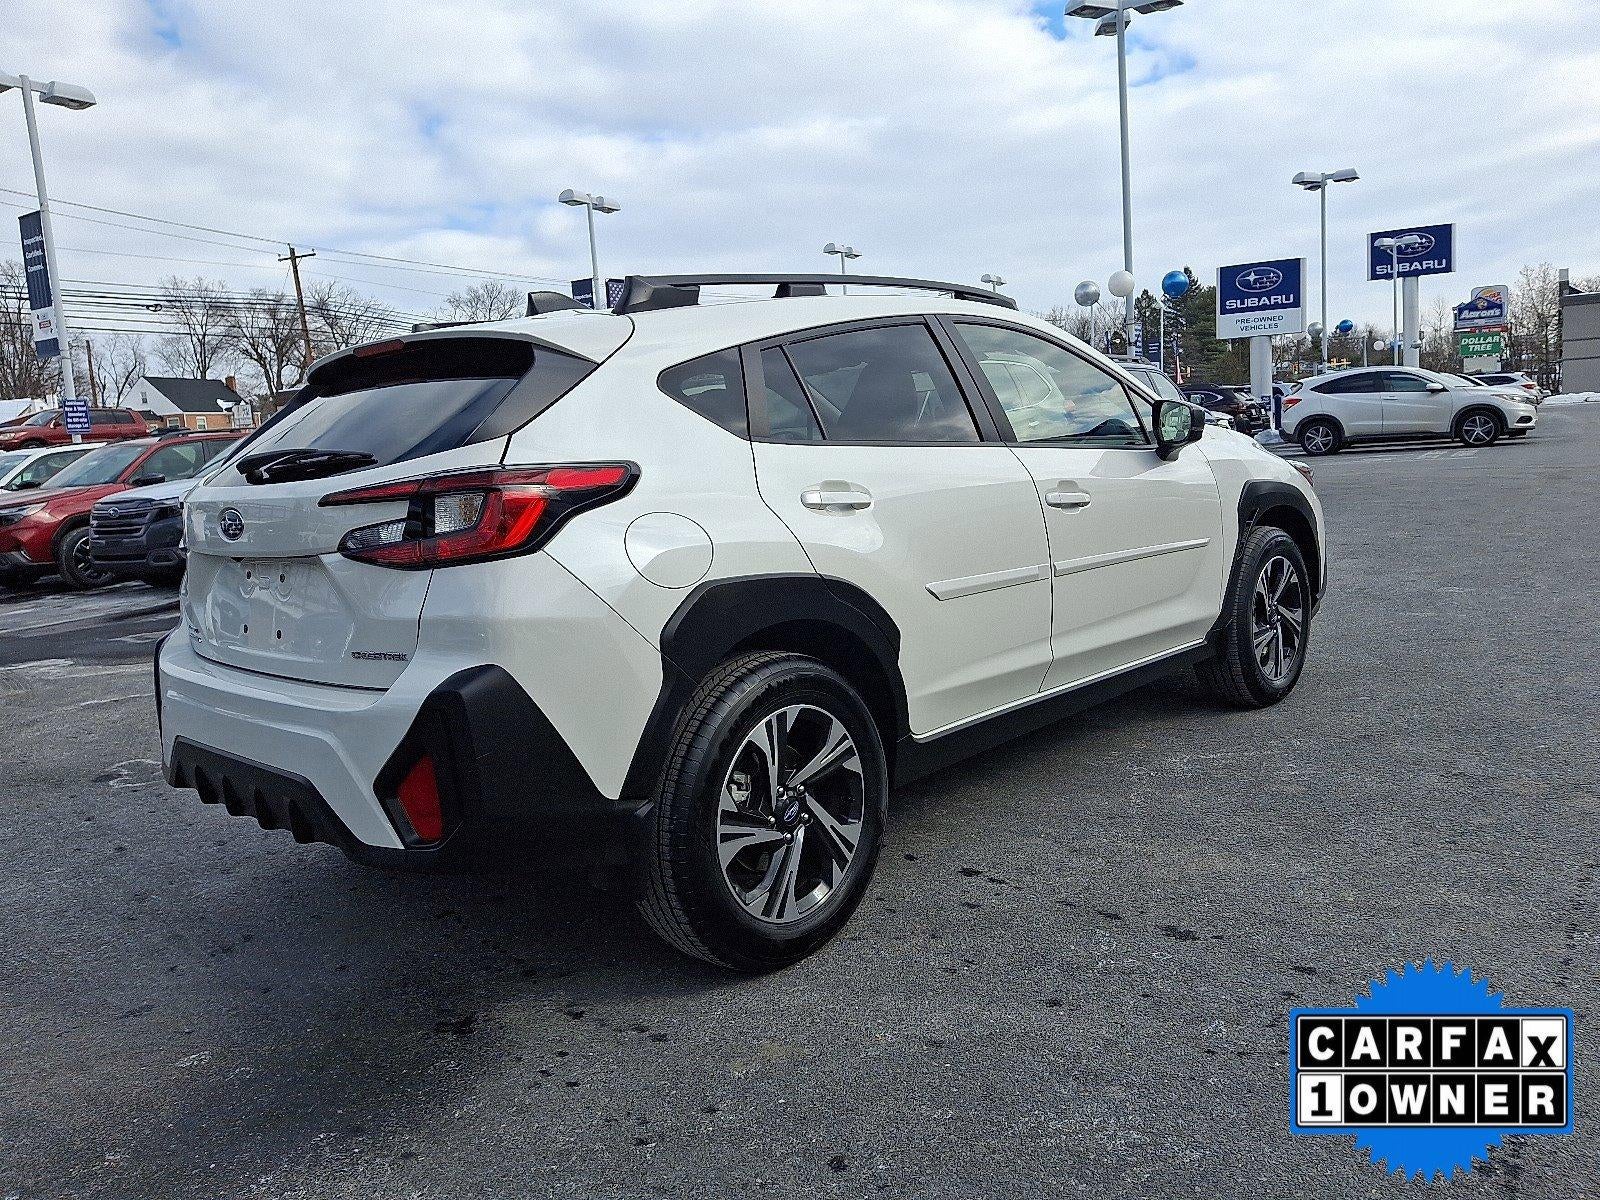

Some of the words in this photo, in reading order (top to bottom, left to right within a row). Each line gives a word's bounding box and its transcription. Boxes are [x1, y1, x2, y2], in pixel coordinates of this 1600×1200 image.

[1376, 259, 1446, 274] SUBARU
[1226, 294, 1294, 309] SUBARU
[1235, 315, 1284, 325] PRE-OWNED
[1240, 323, 1279, 332] VEHICLES
[1461, 336, 1500, 345] DOLLAR
[1468, 344, 1492, 352] TREE
